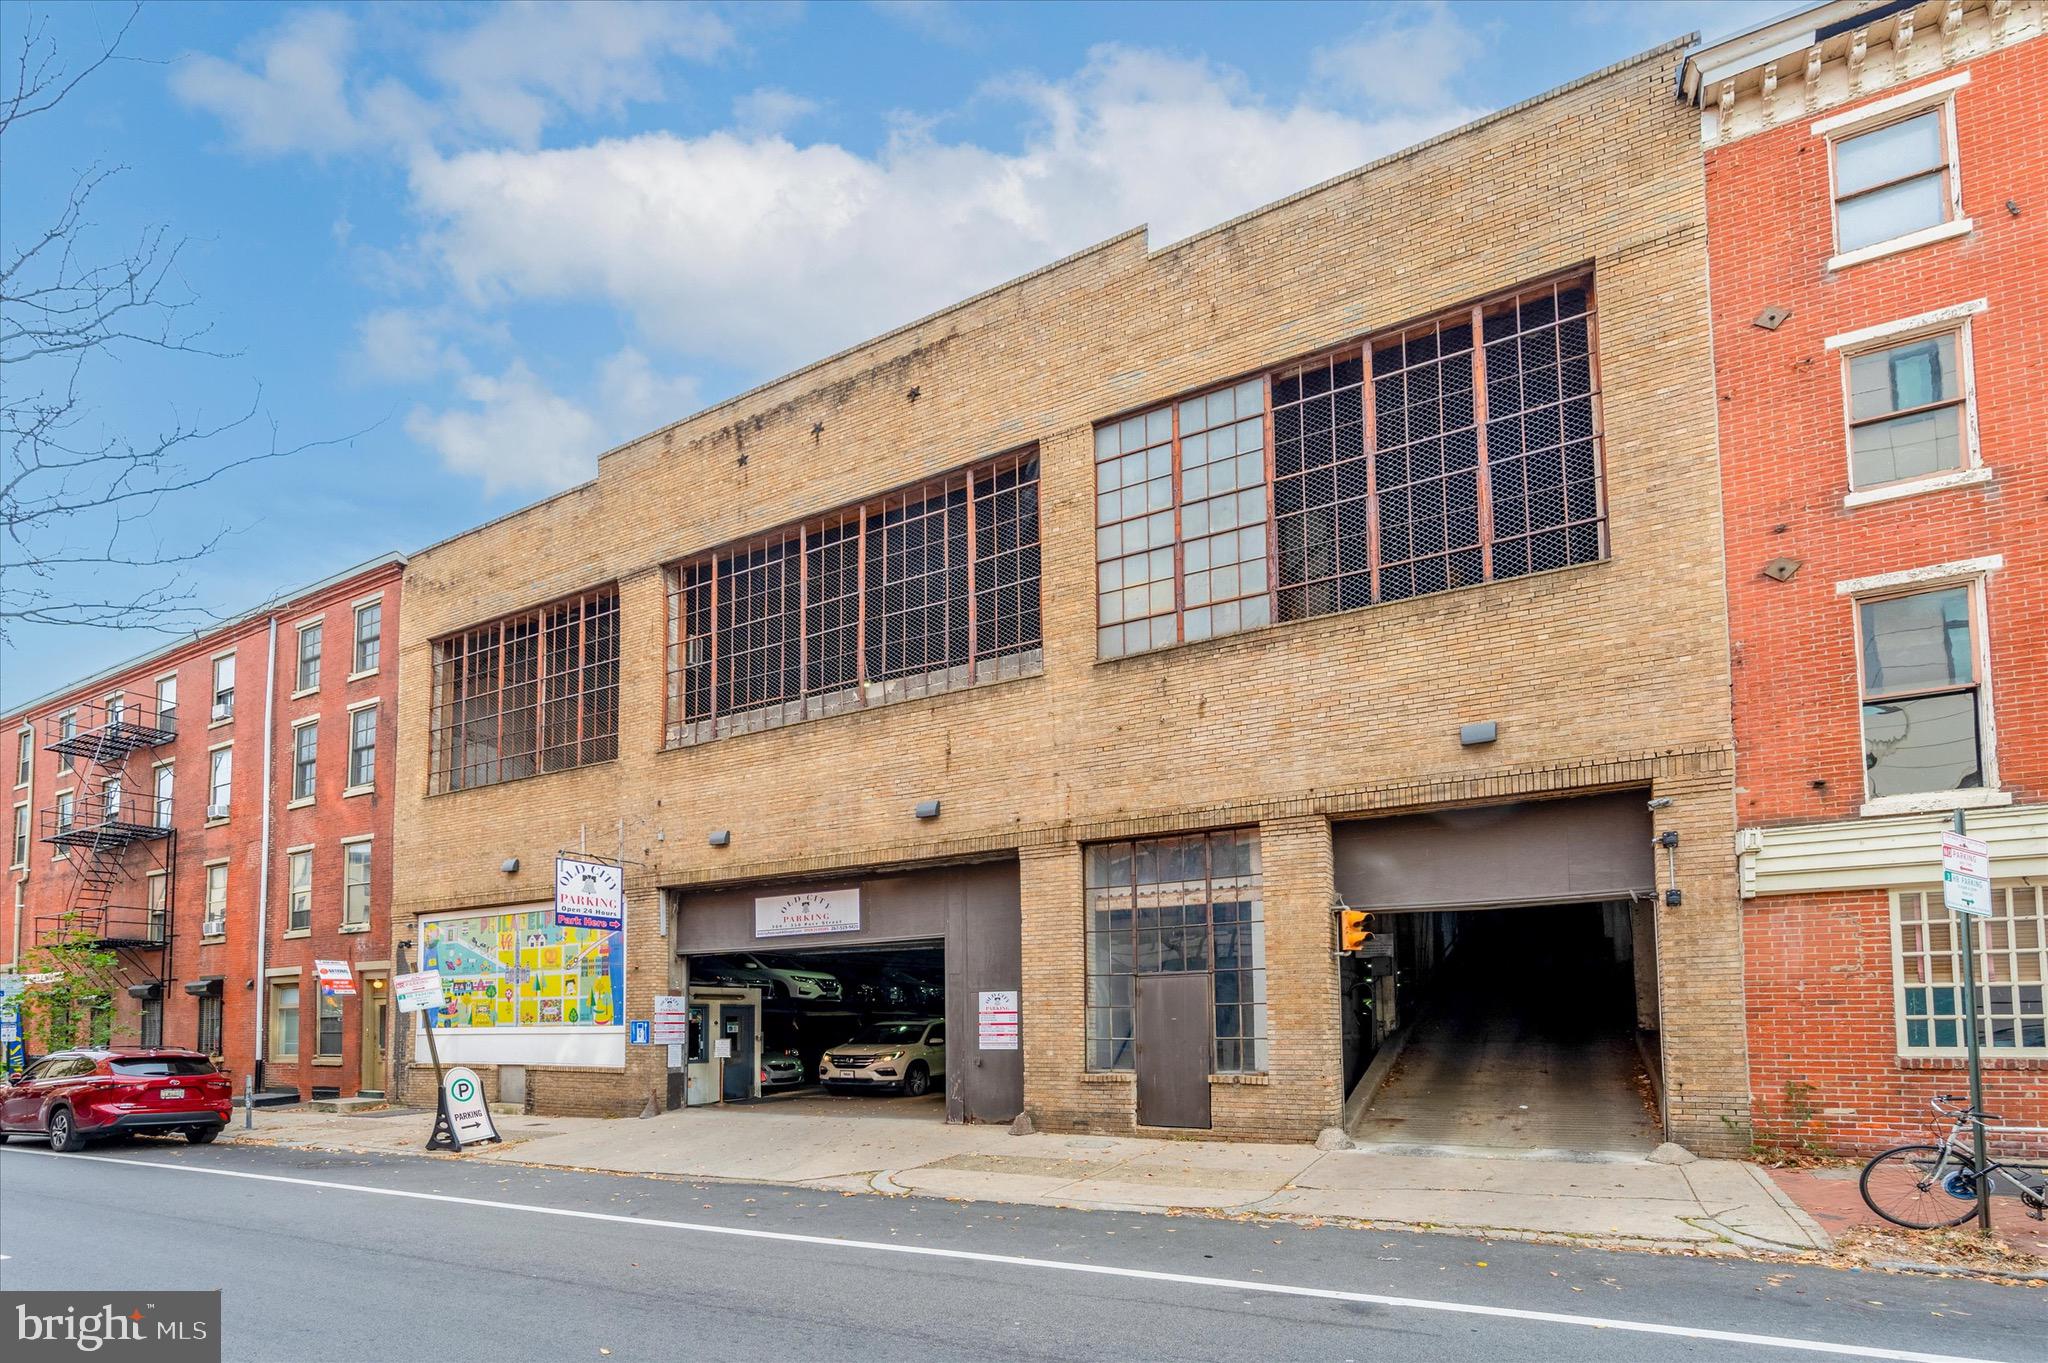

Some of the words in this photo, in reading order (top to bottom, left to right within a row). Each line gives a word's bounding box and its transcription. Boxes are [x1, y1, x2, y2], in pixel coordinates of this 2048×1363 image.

[1953, 851, 1977, 863] PARKING
[560, 865, 585, 886] OLD
[591, 866, 617, 890] CITY
[1961, 876, 1984, 889] PARKING
[560, 894, 617, 909] PARKING
[781, 896, 801, 914] OLD
[806, 894, 831, 910] CITY
[561, 905, 581, 914] Open
[596, 909, 617, 917] Hours
[783, 913, 830, 923] PARKING
[480, 910, 556, 934] PHILADELP
[558, 914, 582, 926] Park
[584, 917, 608, 928] Here
[458, 1083, 469, 1097] P
[454, 1110, 482, 1121] PARKING
